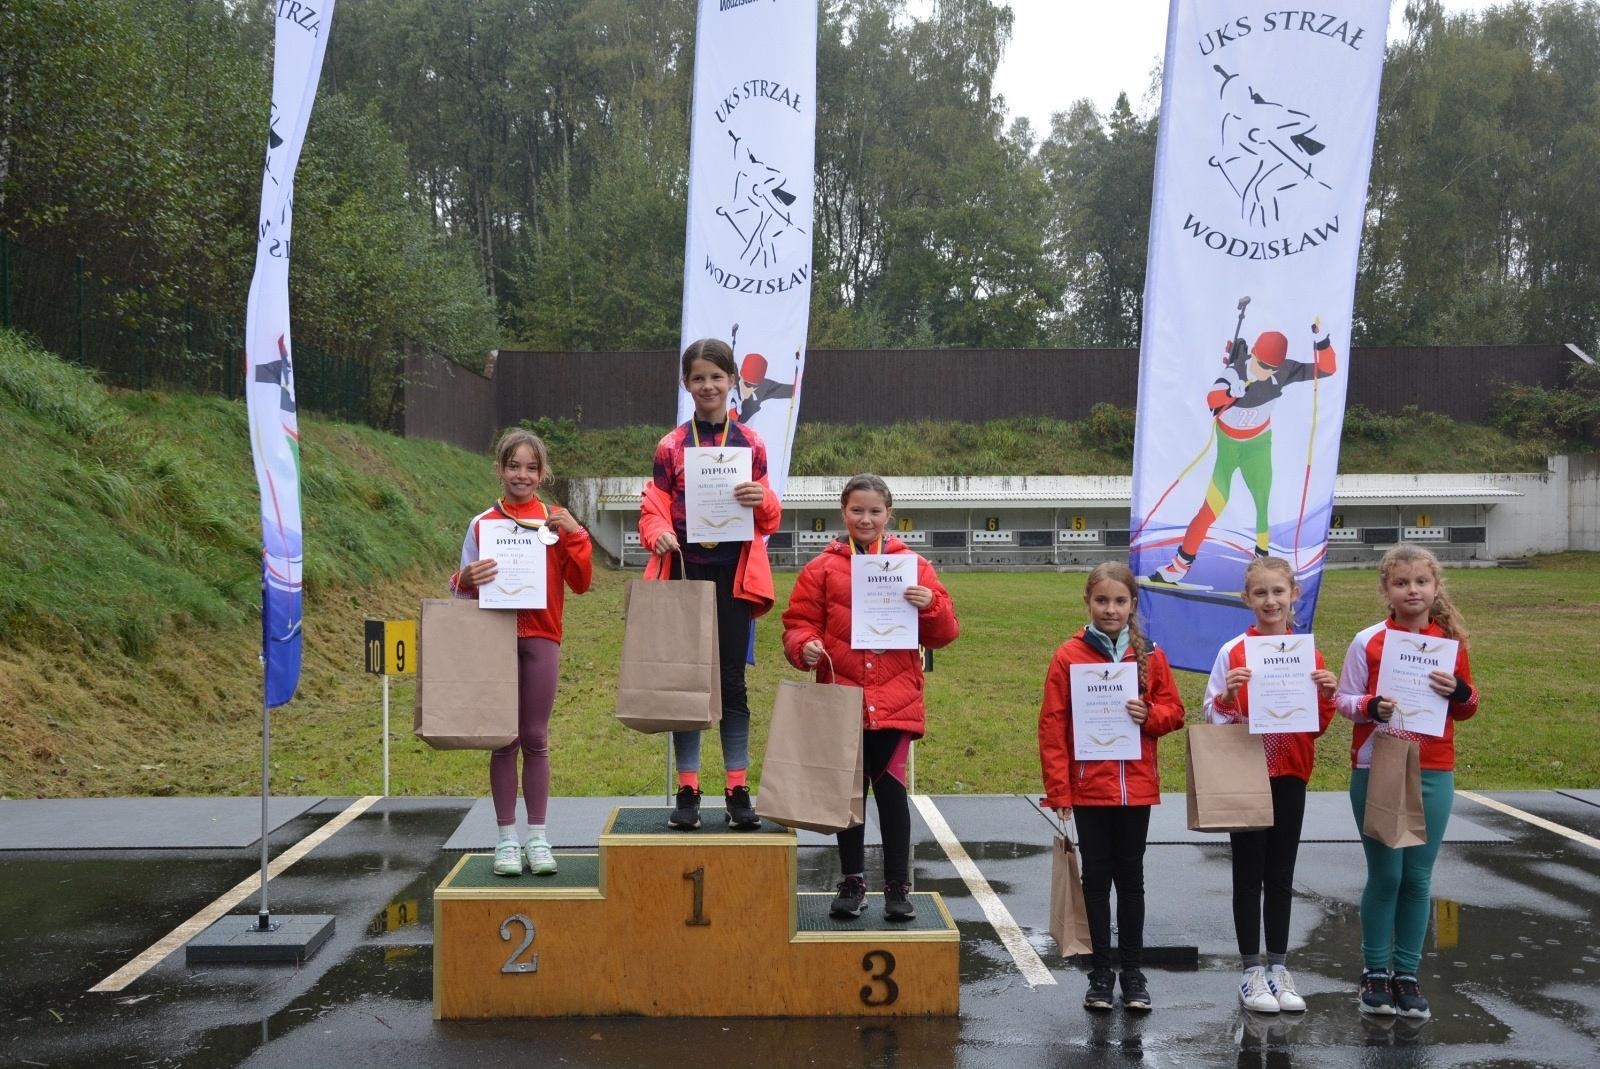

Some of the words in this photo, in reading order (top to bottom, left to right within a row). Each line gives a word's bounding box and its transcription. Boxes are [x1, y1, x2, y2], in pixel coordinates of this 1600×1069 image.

[1199, 16, 1251, 56] UKS
[1263, 11, 1366, 51] STRZAŁ
[714, 87, 740, 123] UKS
[743, 79, 801, 113] STRZAŁ
[1183, 213, 1340, 260] WODZISŁAW
[1238, 409, 1258, 427] 22
[701, 467, 737, 475] DYPLOM
[815, 519, 822, 532] 8
[903, 518, 909, 531] 7
[989, 518, 996, 531] 6
[1075, 517, 1082, 530] 5
[1333, 515, 1341, 528] 2
[867, 575, 903, 583] DYPLOM
[369, 639, 381, 672] 10
[396, 640, 405, 672] 9
[1263, 656, 1301, 665] DYPLOM
[1399, 653, 1439, 667] DYPLOM
[1087, 684, 1123, 692] DYPLOM
[682, 865, 711, 927] 1
[500, 913, 538, 974] 2
[859, 949, 899, 1007] 3
